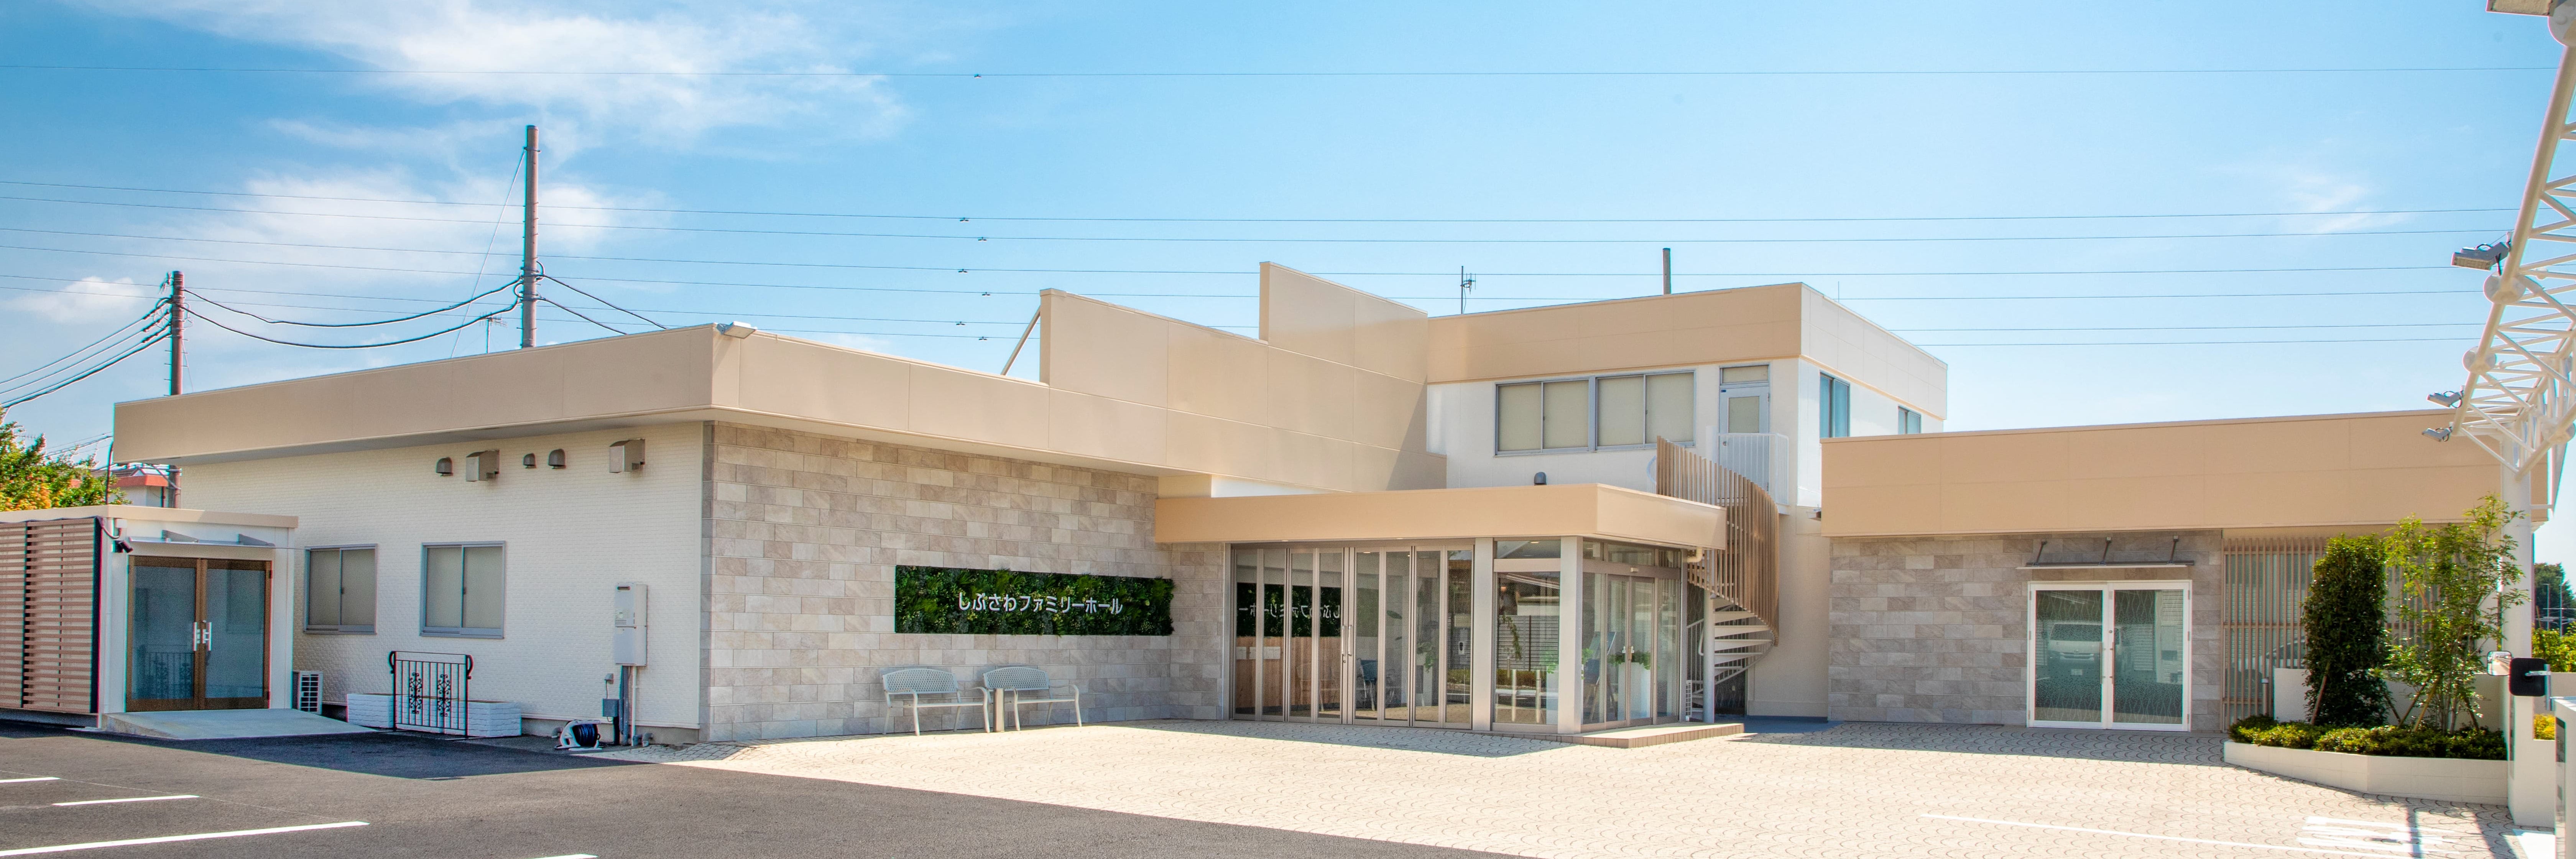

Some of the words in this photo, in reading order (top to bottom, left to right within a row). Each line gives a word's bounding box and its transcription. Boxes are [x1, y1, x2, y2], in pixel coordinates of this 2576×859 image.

[959, 592, 1123, 614] しぶさわファミリーホール
